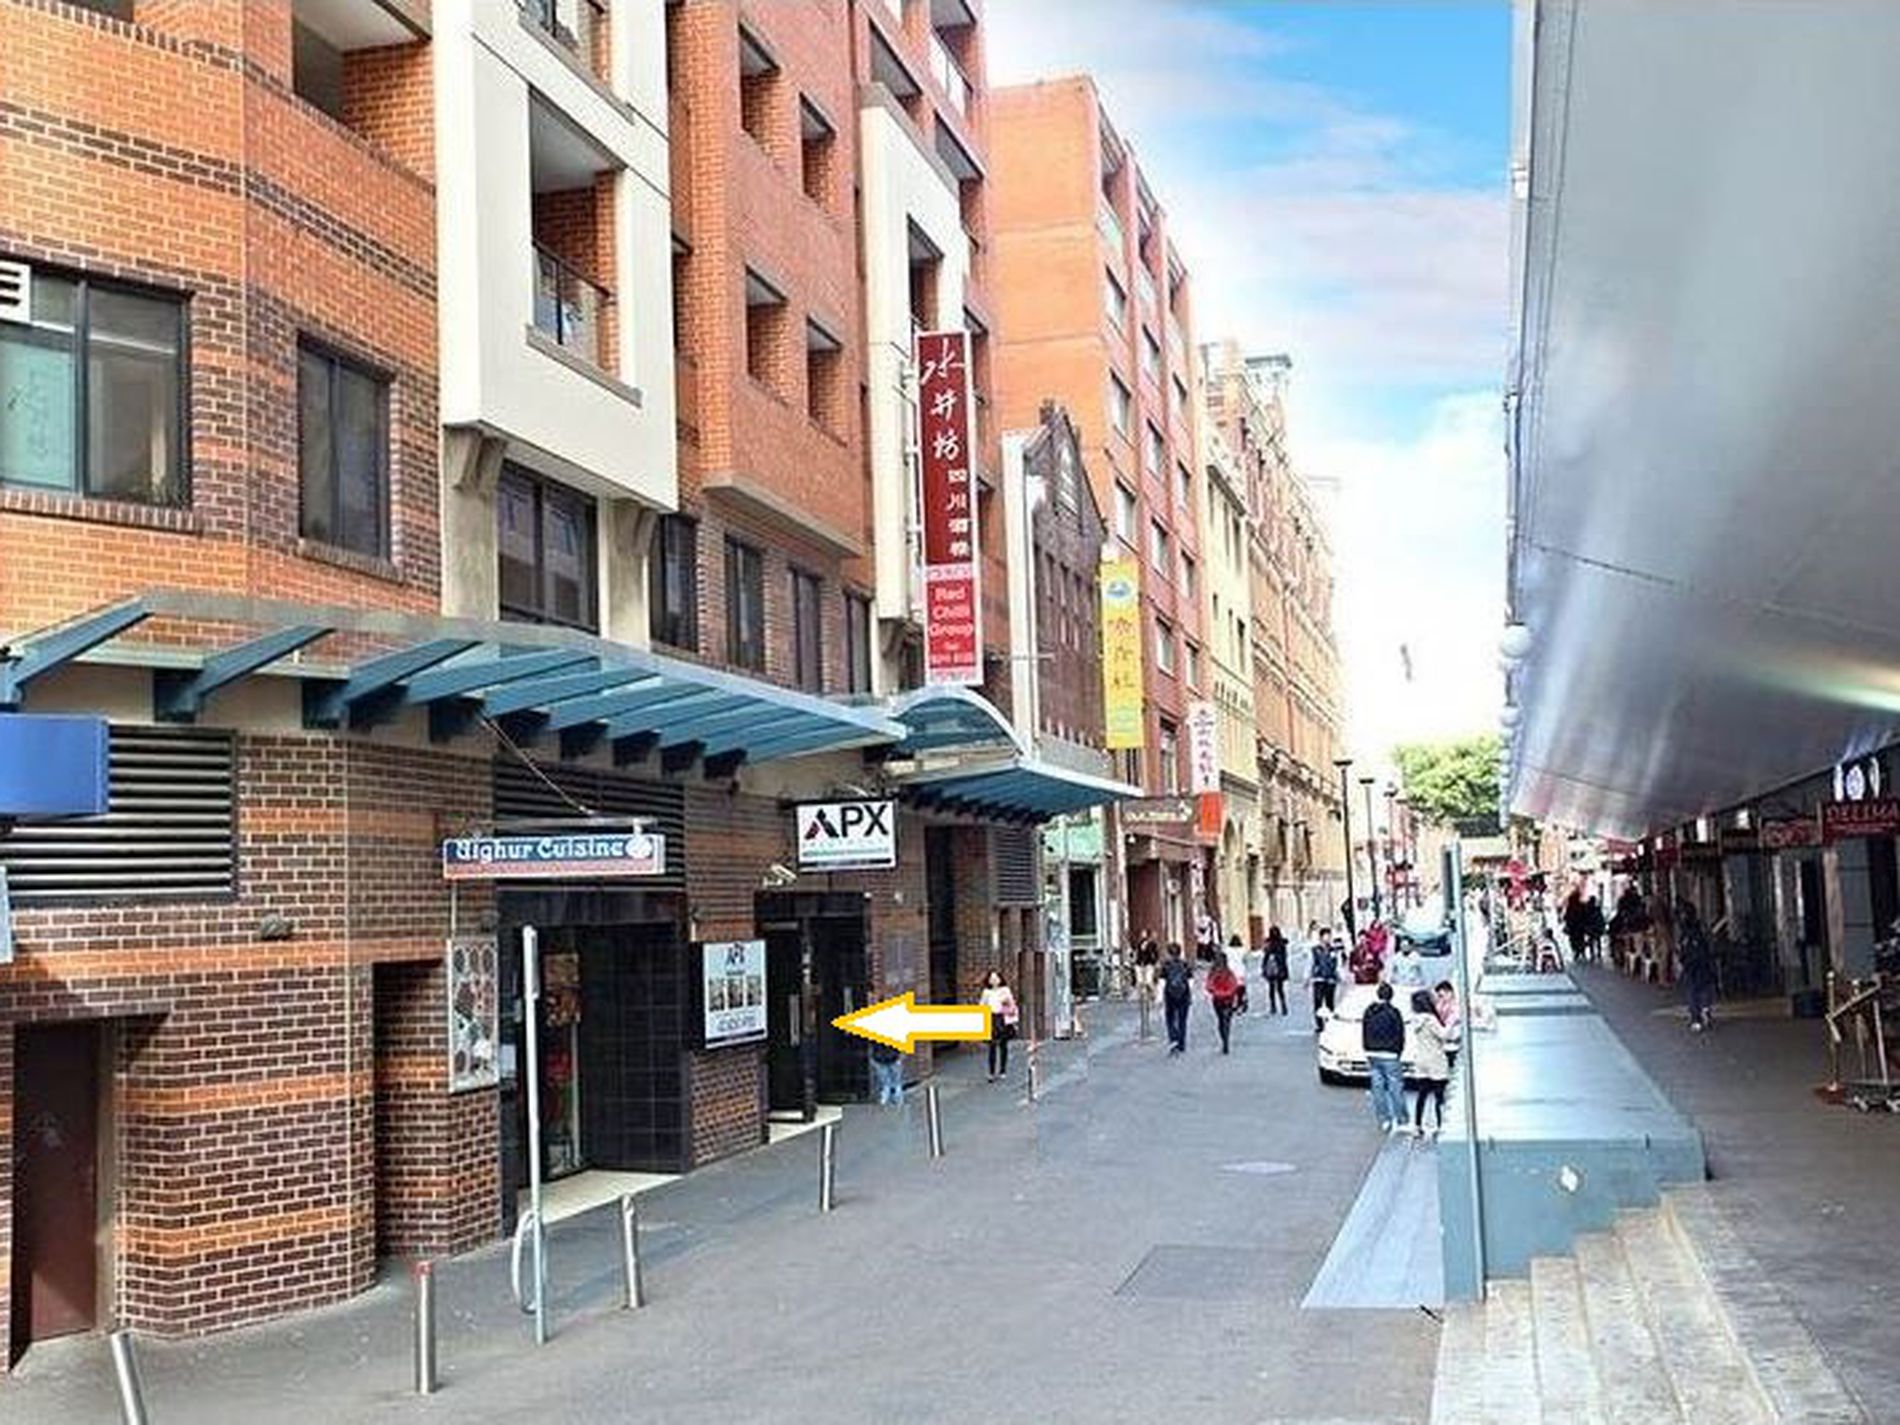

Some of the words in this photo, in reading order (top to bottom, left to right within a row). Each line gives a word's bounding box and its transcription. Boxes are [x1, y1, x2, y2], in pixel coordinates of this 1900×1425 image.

[934, 587, 966, 601] Red
[805, 803, 889, 840] APX
[456, 840, 534, 862] Uighur
[536, 839, 624, 858] Cuisine
